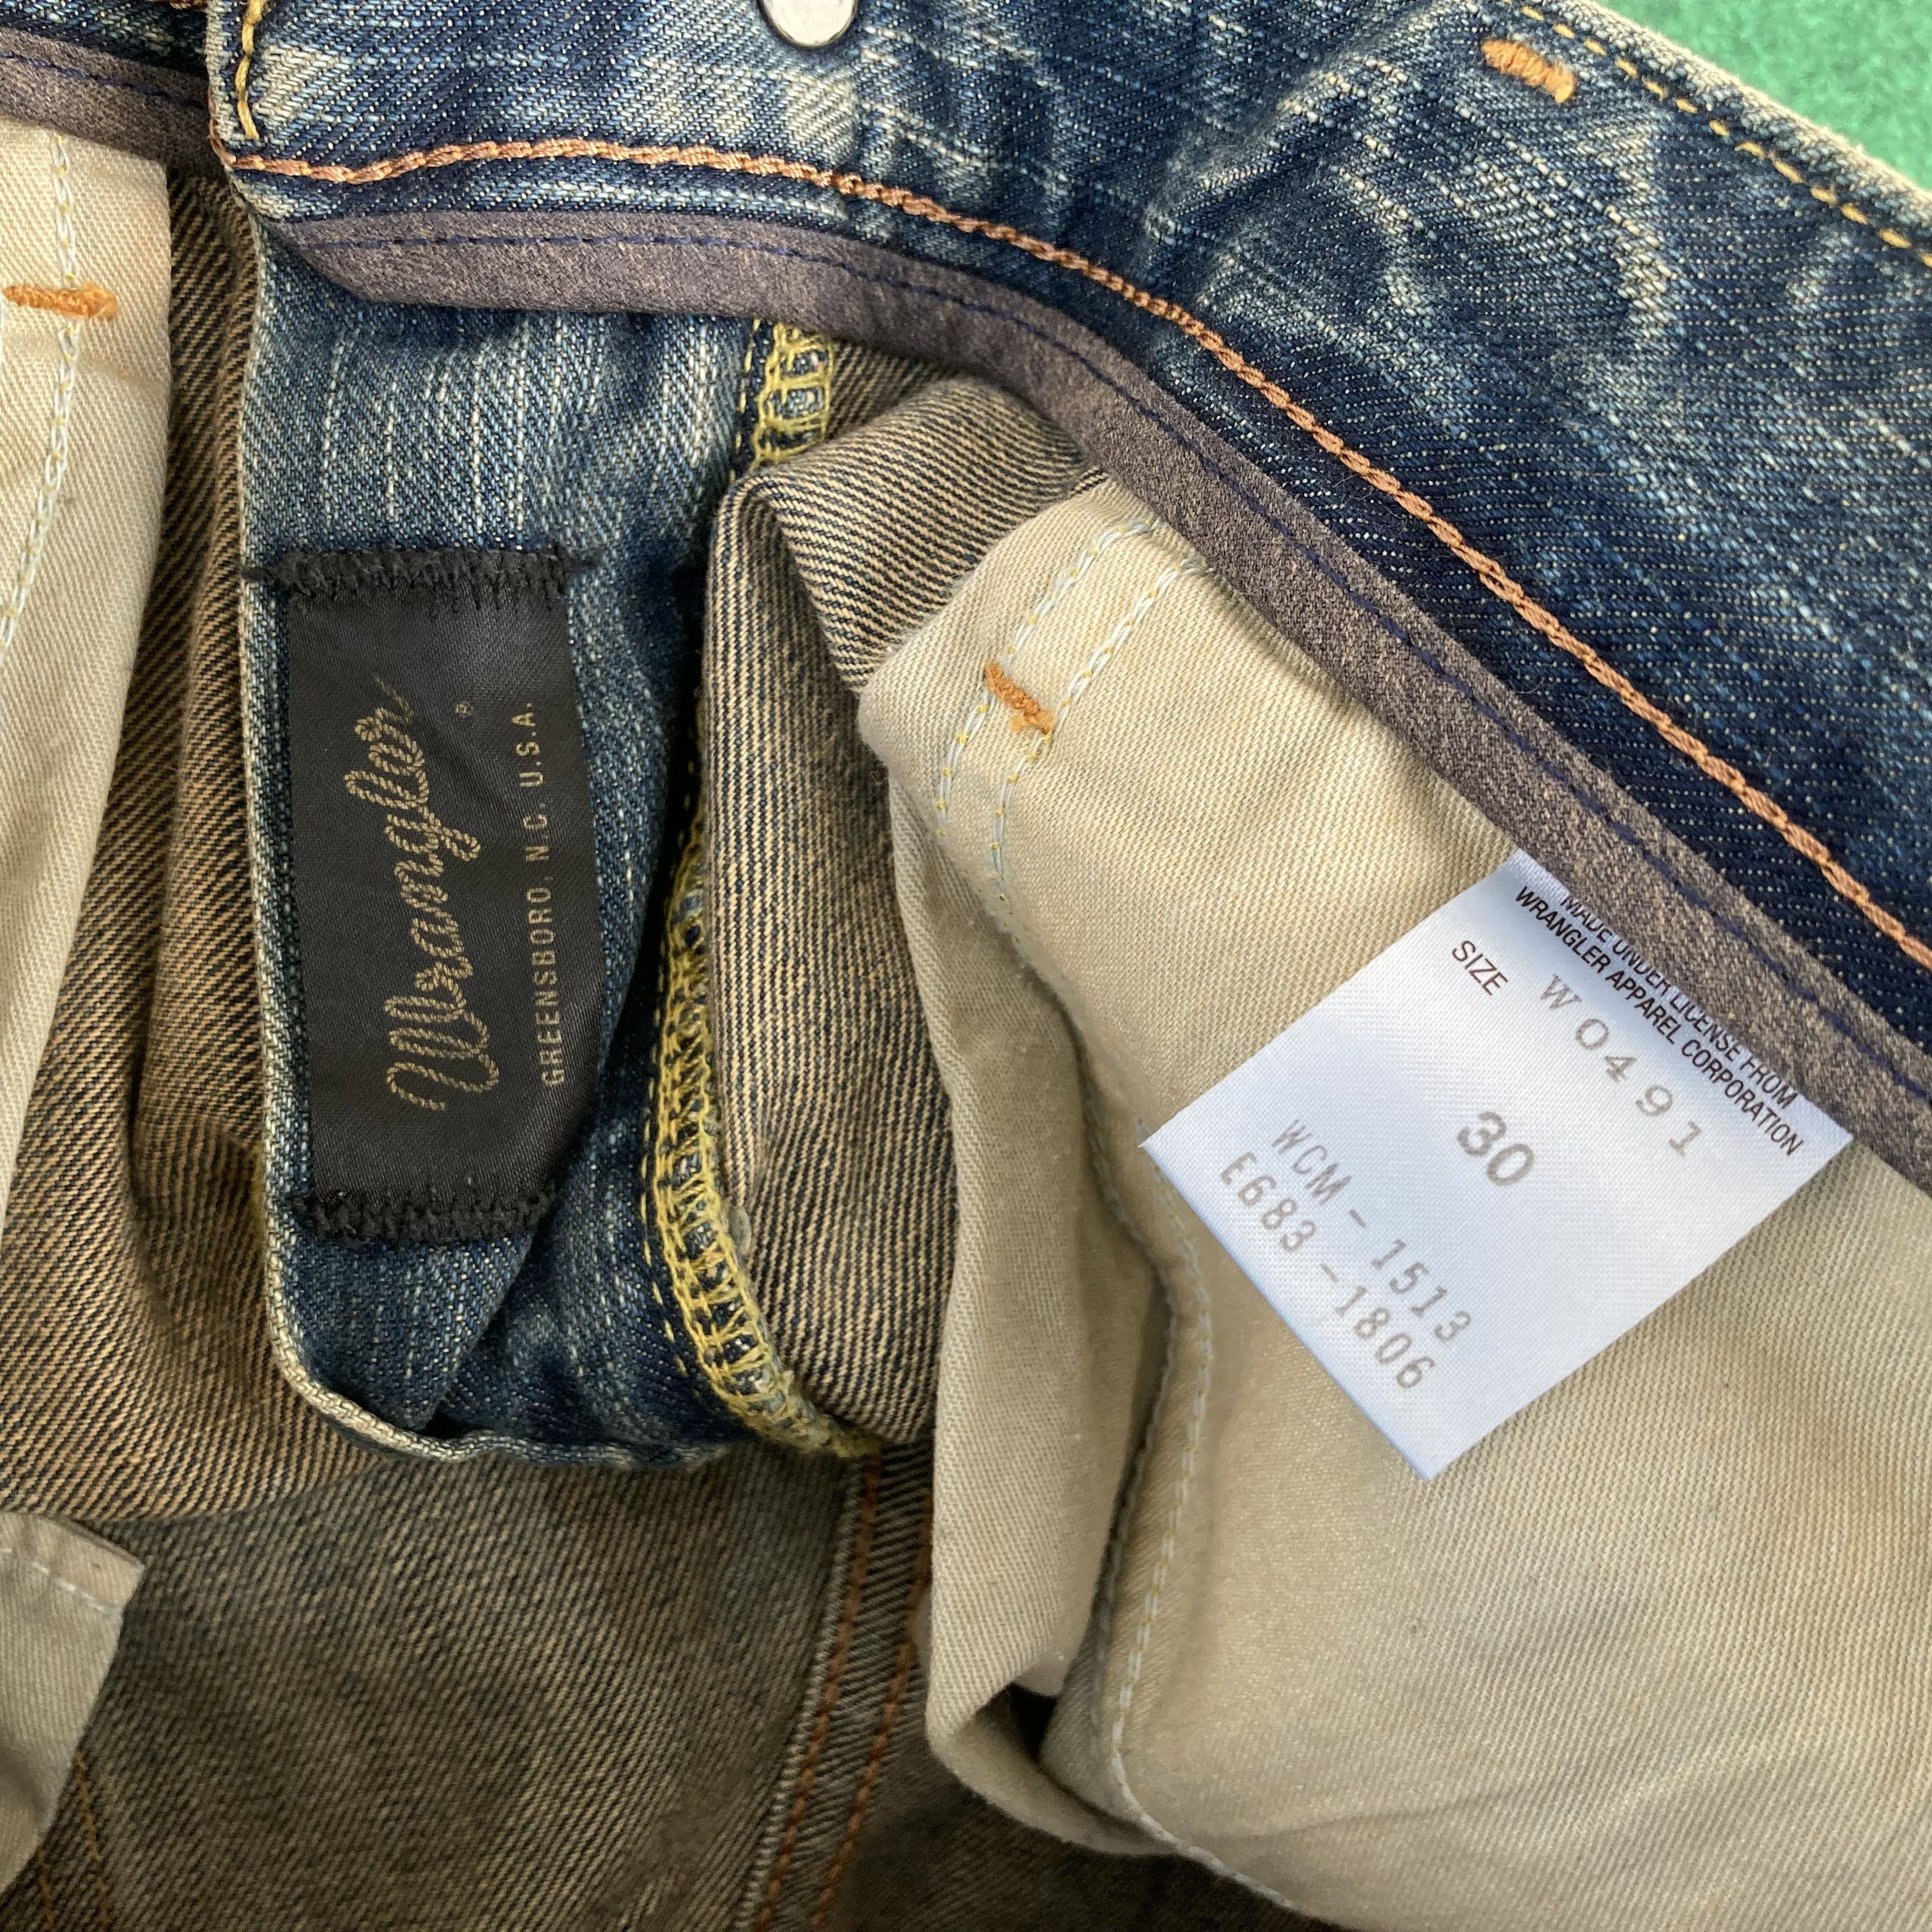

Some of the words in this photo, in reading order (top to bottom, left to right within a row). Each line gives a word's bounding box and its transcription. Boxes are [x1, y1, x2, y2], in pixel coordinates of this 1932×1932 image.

[511, 702, 544, 788] U.S.A.
[344, 678, 499, 1111] Wrangler
[1452, 940, 1508, 996] SIZE
[1515, 886, 1611, 974] WRANGLER
[1605, 970, 1681, 1045] APPAREL
[1682, 1039, 1804, 1156] CORPORATION
[1457, 1110, 1535, 1186] 30
